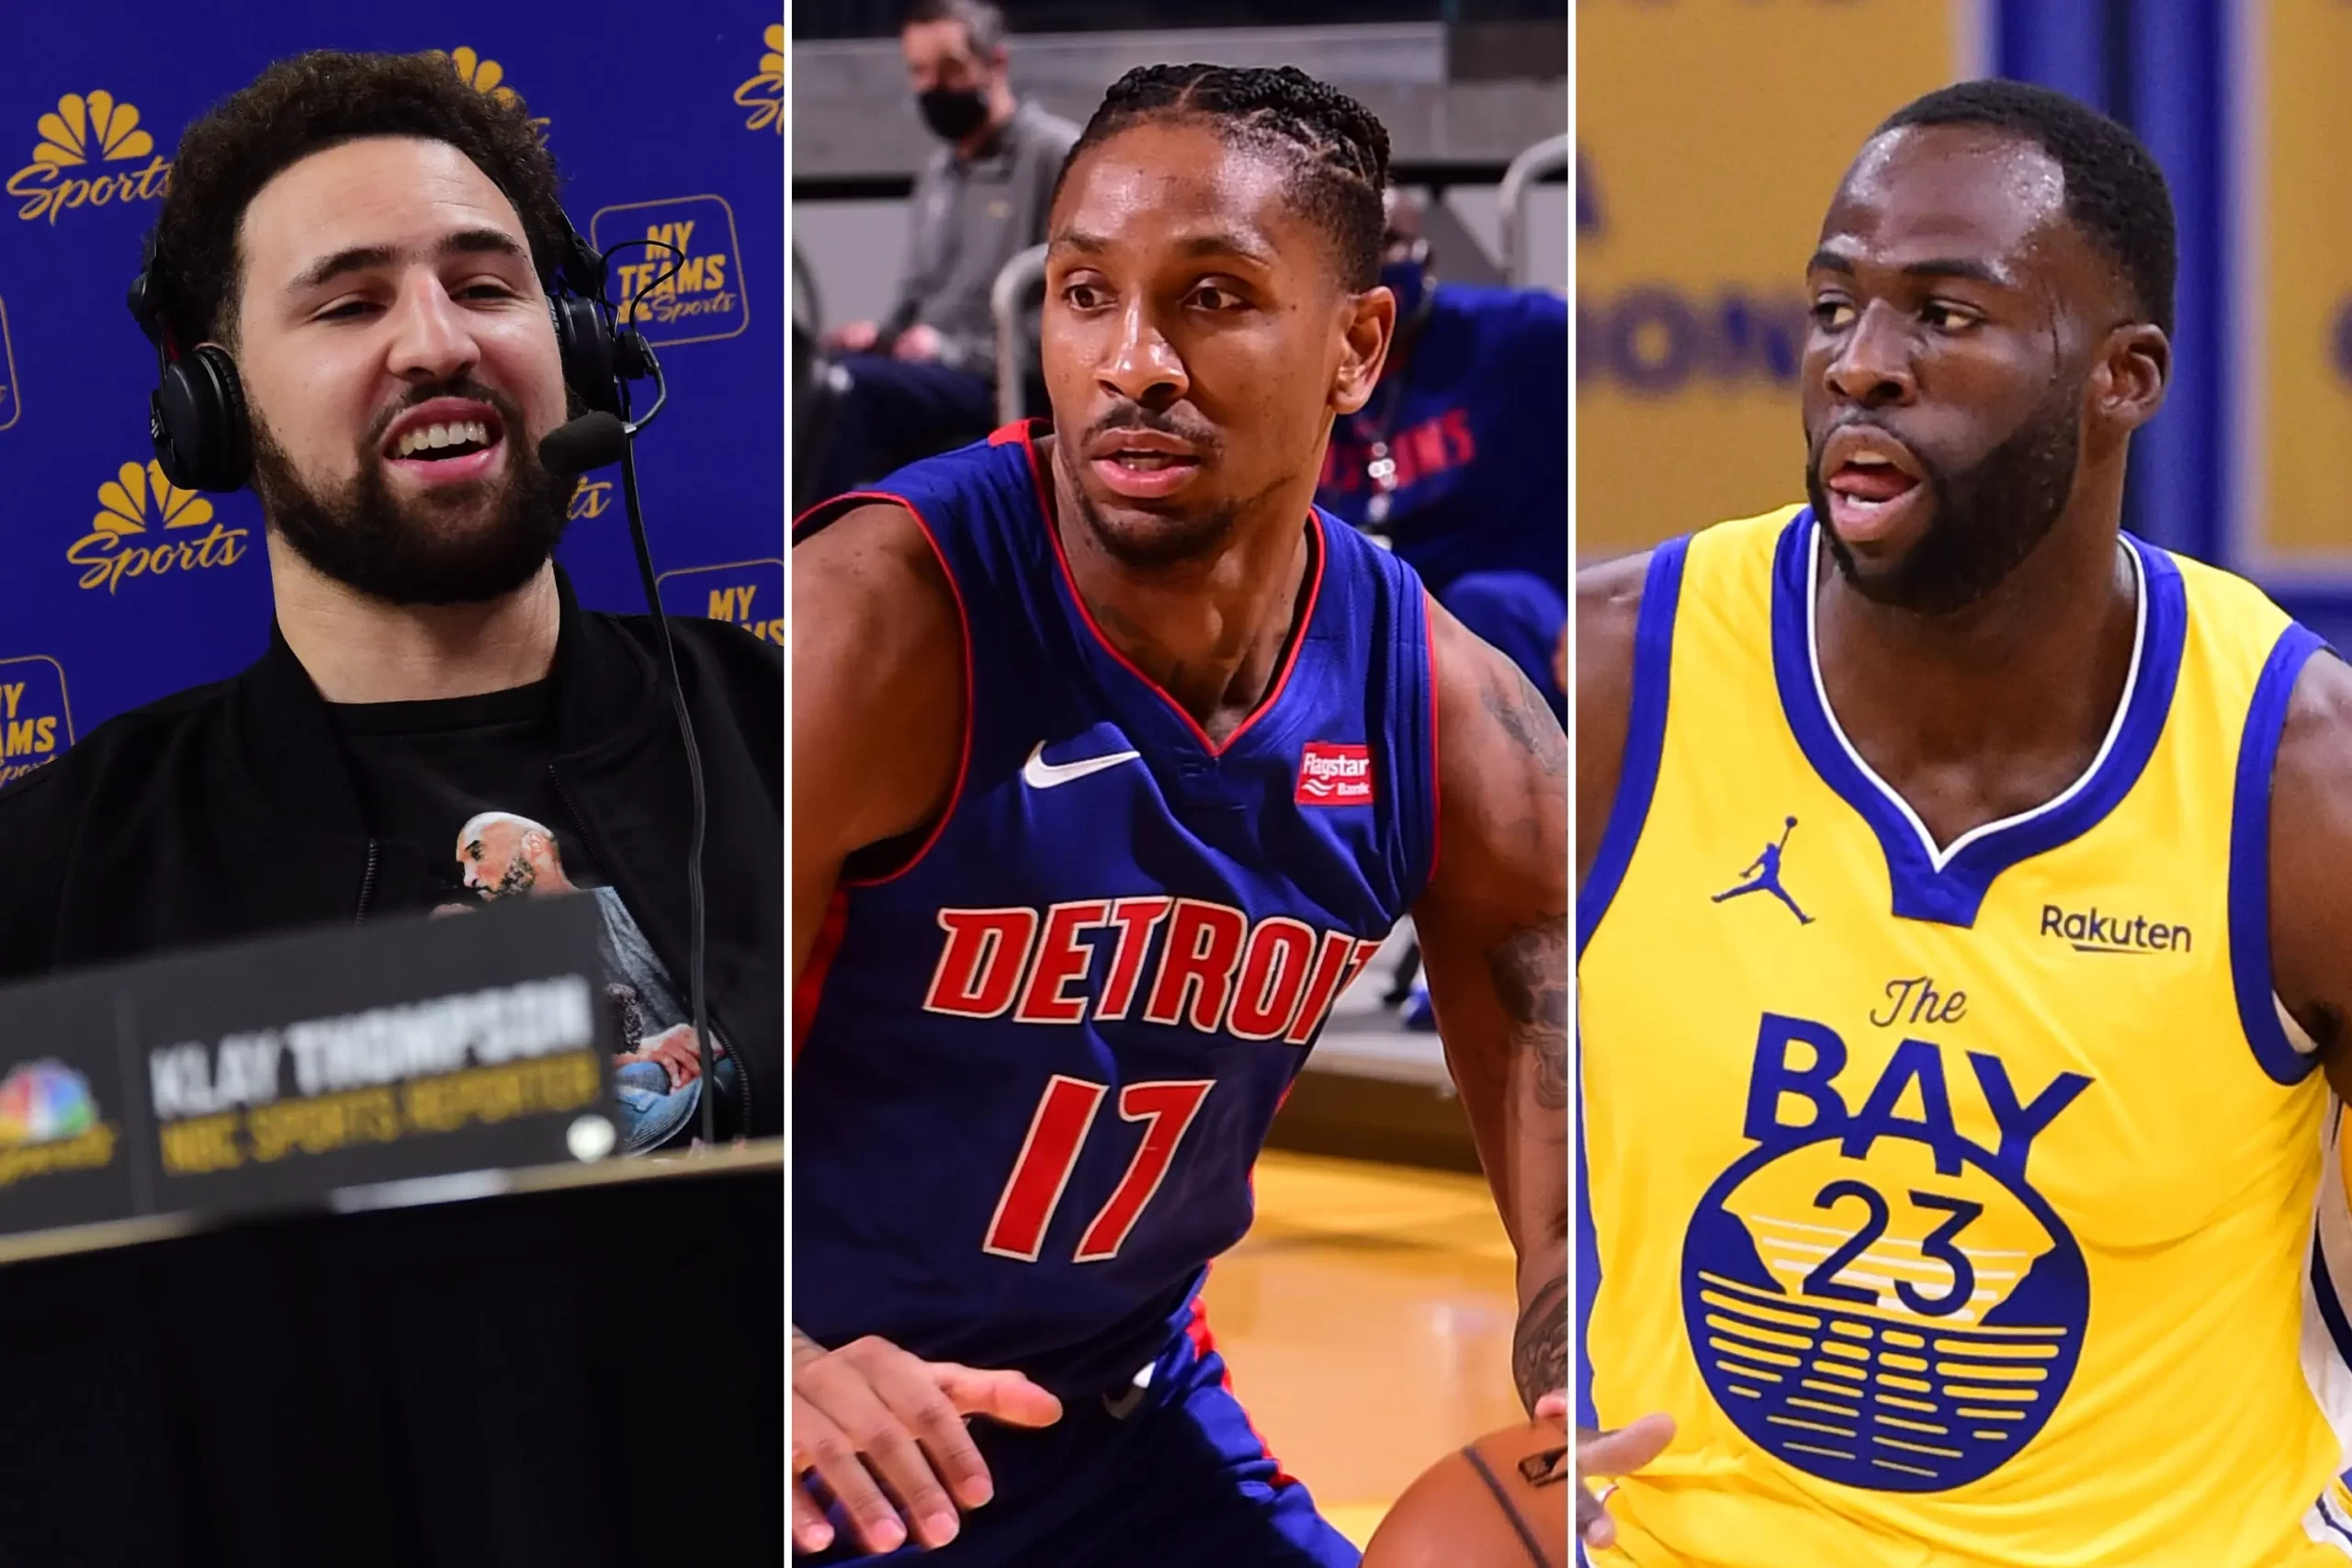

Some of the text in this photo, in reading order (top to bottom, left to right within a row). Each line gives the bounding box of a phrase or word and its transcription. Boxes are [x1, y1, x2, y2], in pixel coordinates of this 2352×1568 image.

[645, 220, 695, 261] MY
[616, 254, 727, 299] TEAMS
[650, 290, 737, 324] Sports
[66, 523, 249, 596] Sports
[707, 584, 757, 623] MY
[1303, 752, 1370, 781] Flagstar
[2040, 904, 2192, 953] Rakuten
[1869, 976, 1968, 1028] The
[1743, 1011, 2097, 1183] BAY
[982, 1074, 1217, 1263] 17
[1803, 1179, 1984, 1316] 23
